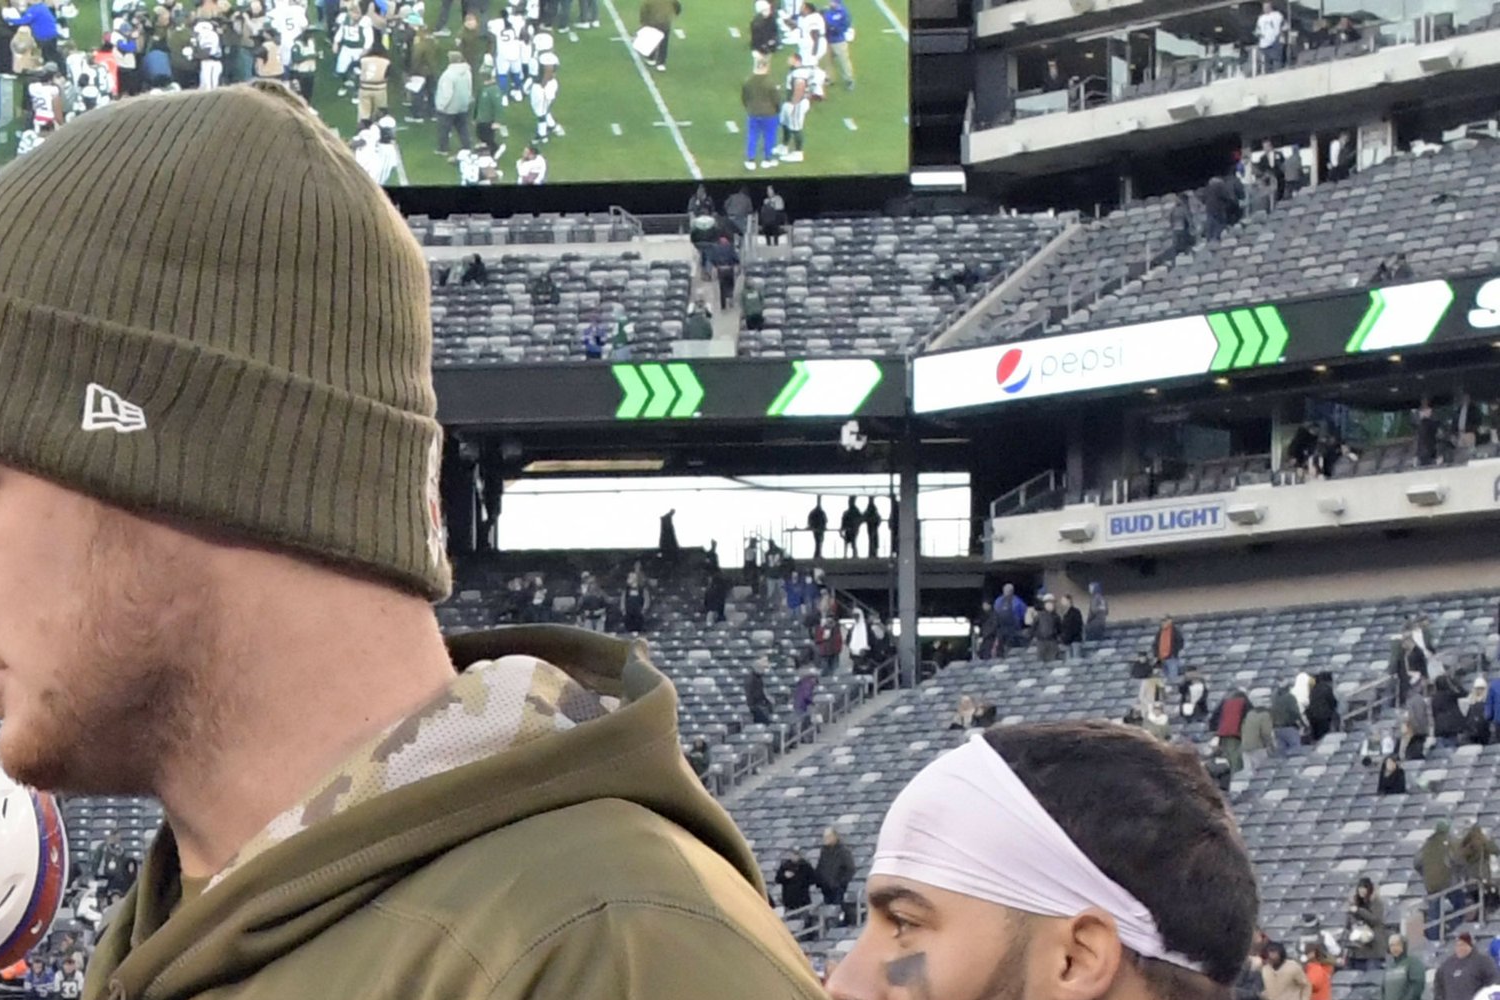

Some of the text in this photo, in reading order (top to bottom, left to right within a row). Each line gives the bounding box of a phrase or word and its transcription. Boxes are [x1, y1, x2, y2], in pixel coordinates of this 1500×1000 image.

[1041, 341, 1123, 384] pepsi
[1110, 507, 1221, 535] BUD LIGHT
